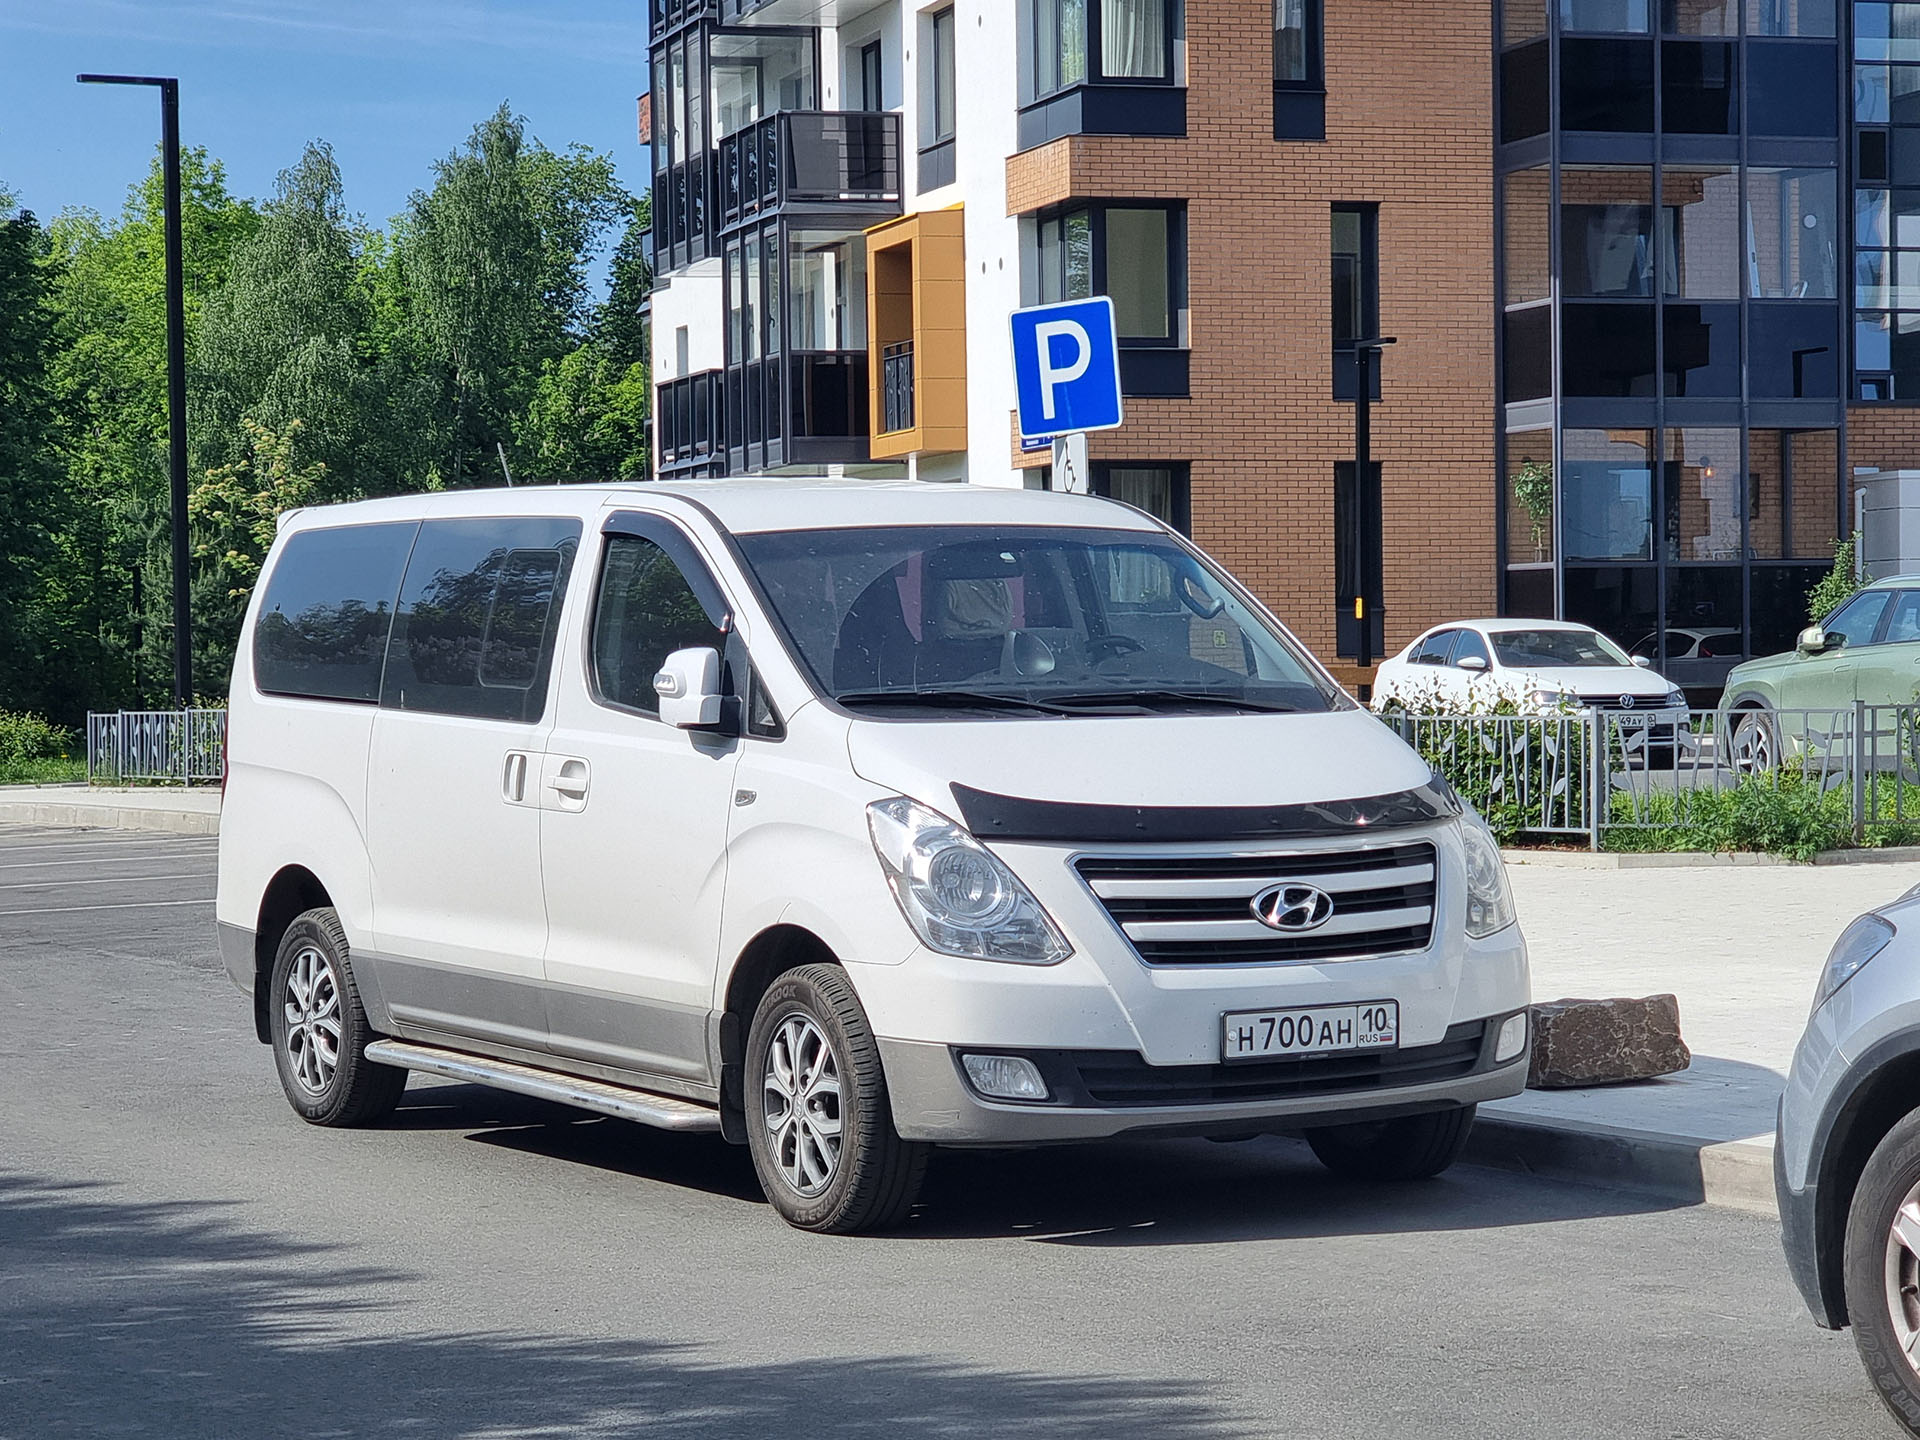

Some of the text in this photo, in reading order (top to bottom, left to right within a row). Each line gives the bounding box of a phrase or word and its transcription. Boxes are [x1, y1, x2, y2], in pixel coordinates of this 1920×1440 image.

[1035, 319, 1092, 420] P
[1238, 1007, 1387, 1052] Н700АН 10
[1359, 1033, 1379, 1044] RUS
